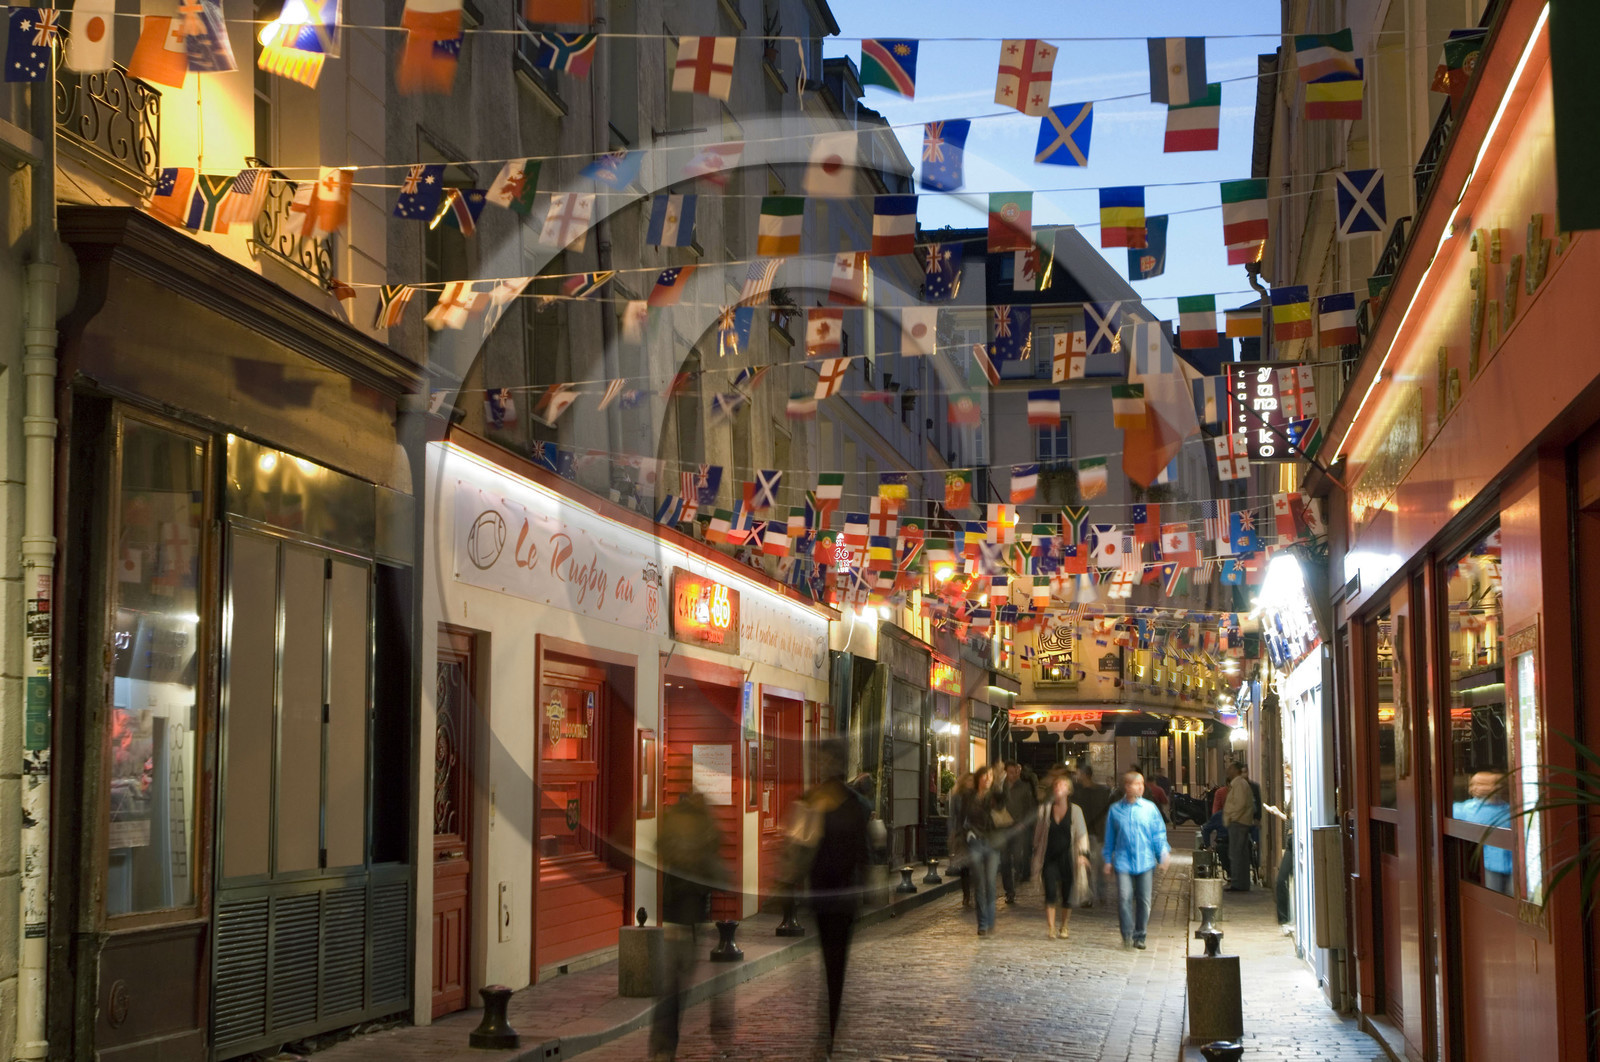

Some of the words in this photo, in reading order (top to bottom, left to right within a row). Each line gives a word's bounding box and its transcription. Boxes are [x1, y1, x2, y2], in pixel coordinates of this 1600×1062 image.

[514, 516, 539, 571] Le
[548, 532, 608, 610] Rugby
[614, 574, 635, 604] au
[648, 588, 657, 615] 66
